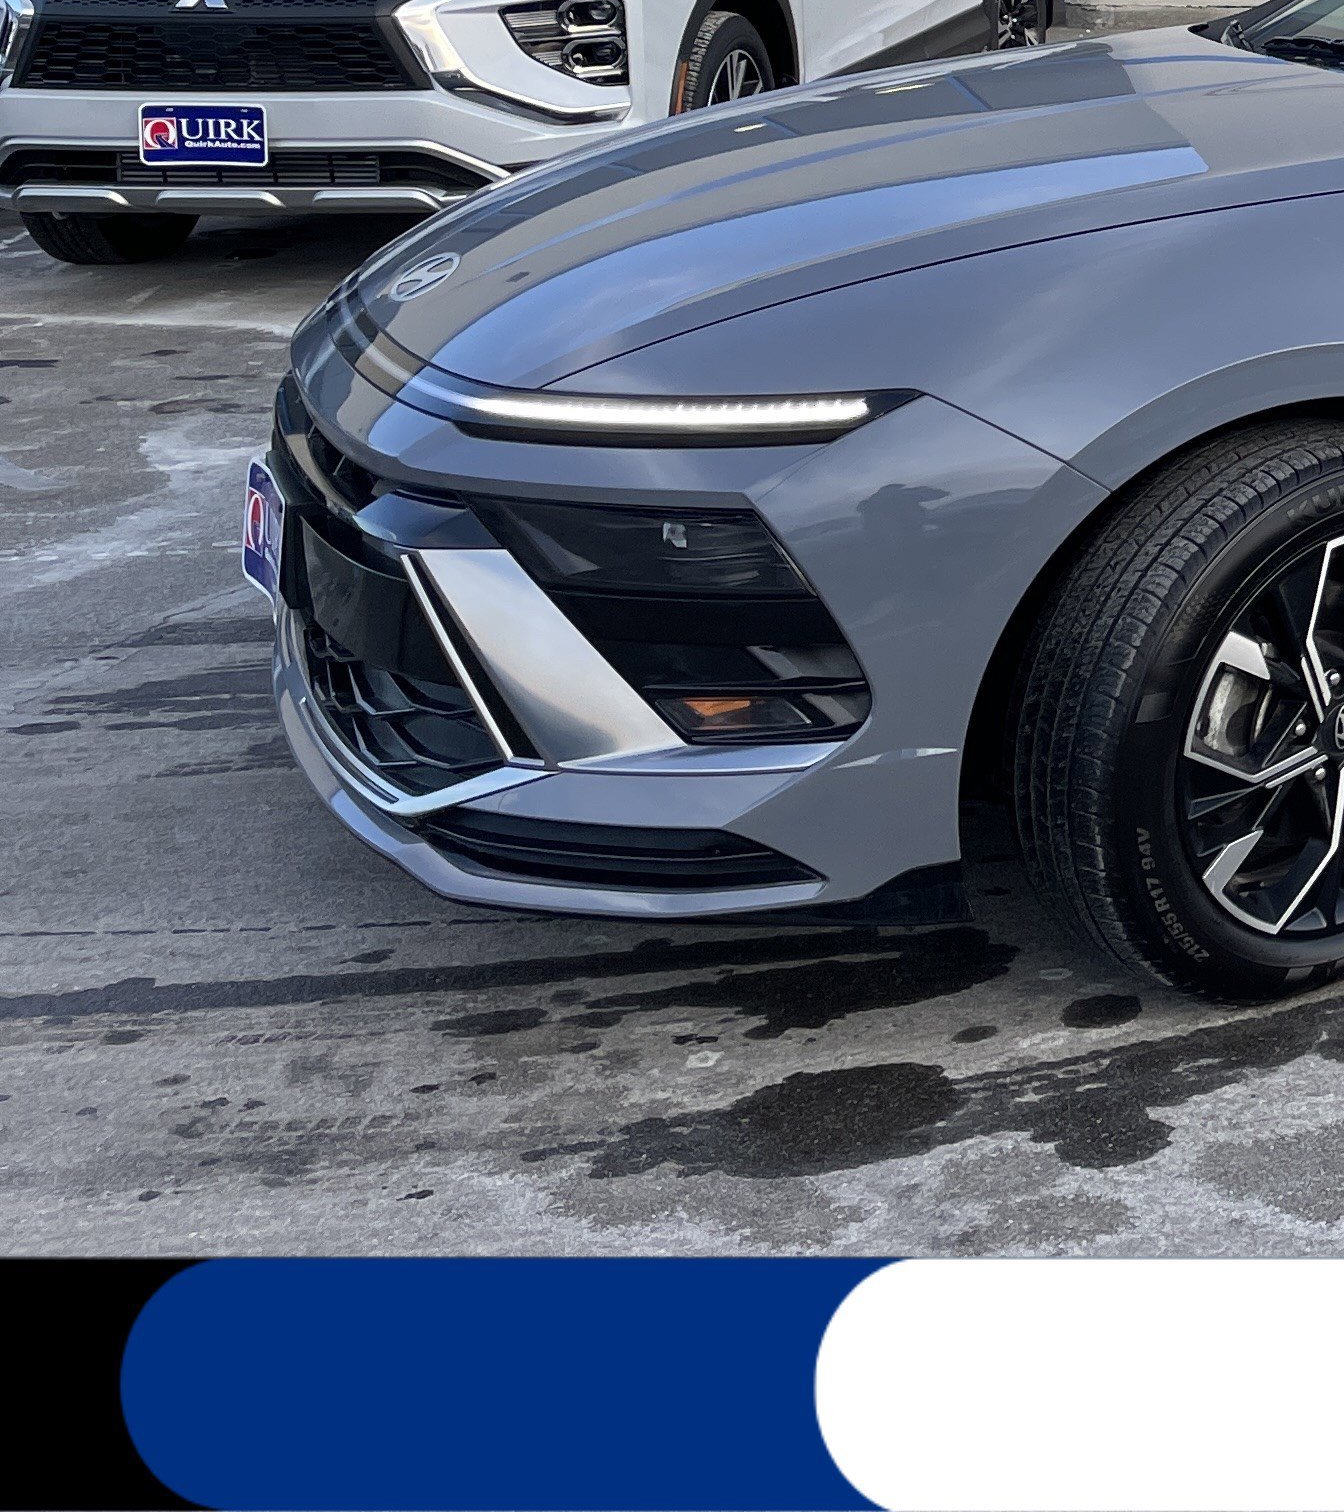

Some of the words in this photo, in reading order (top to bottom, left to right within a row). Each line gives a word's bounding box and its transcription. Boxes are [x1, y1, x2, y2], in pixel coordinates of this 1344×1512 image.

[143, 117, 263, 150] QUIRK
[184, 140, 261, 150] QuirkAuto.com
[1136, 826, 1156, 871] 94V
[1145, 877, 1171, 913] R17
[1160, 912, 1210, 963] 215/55
